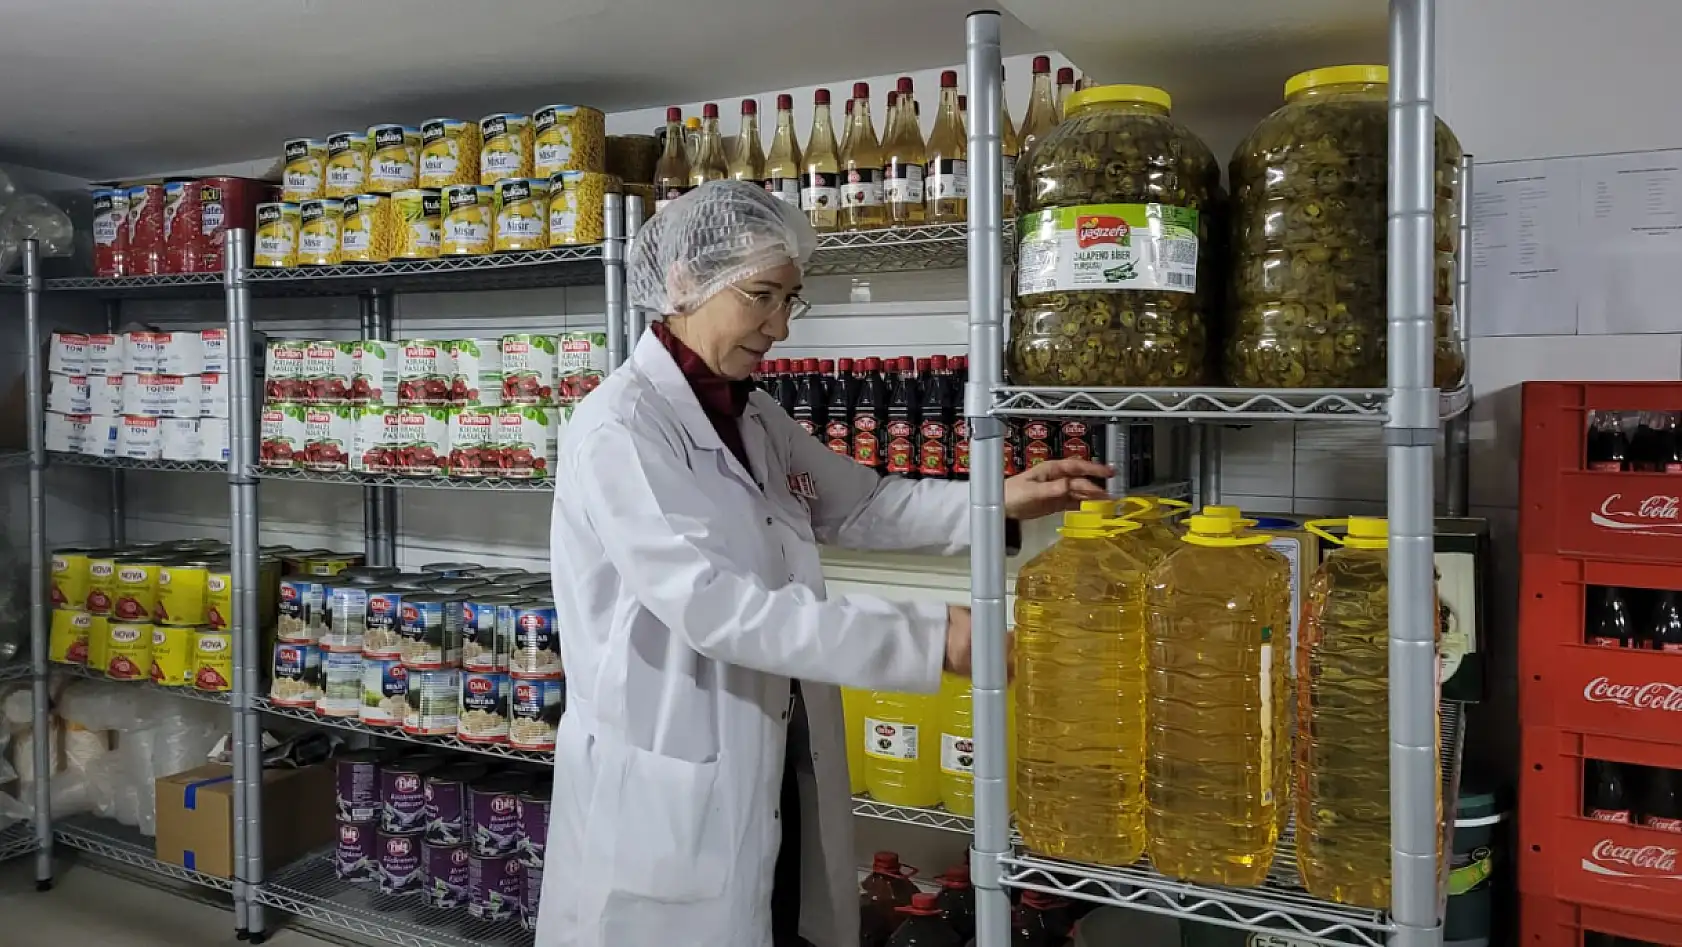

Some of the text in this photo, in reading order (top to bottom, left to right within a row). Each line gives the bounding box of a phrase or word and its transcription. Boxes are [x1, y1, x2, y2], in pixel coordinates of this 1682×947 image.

[122, 571, 143, 582] NOVA
[114, 629, 139, 640] NOVA
[199, 640, 222, 651] NOVA
